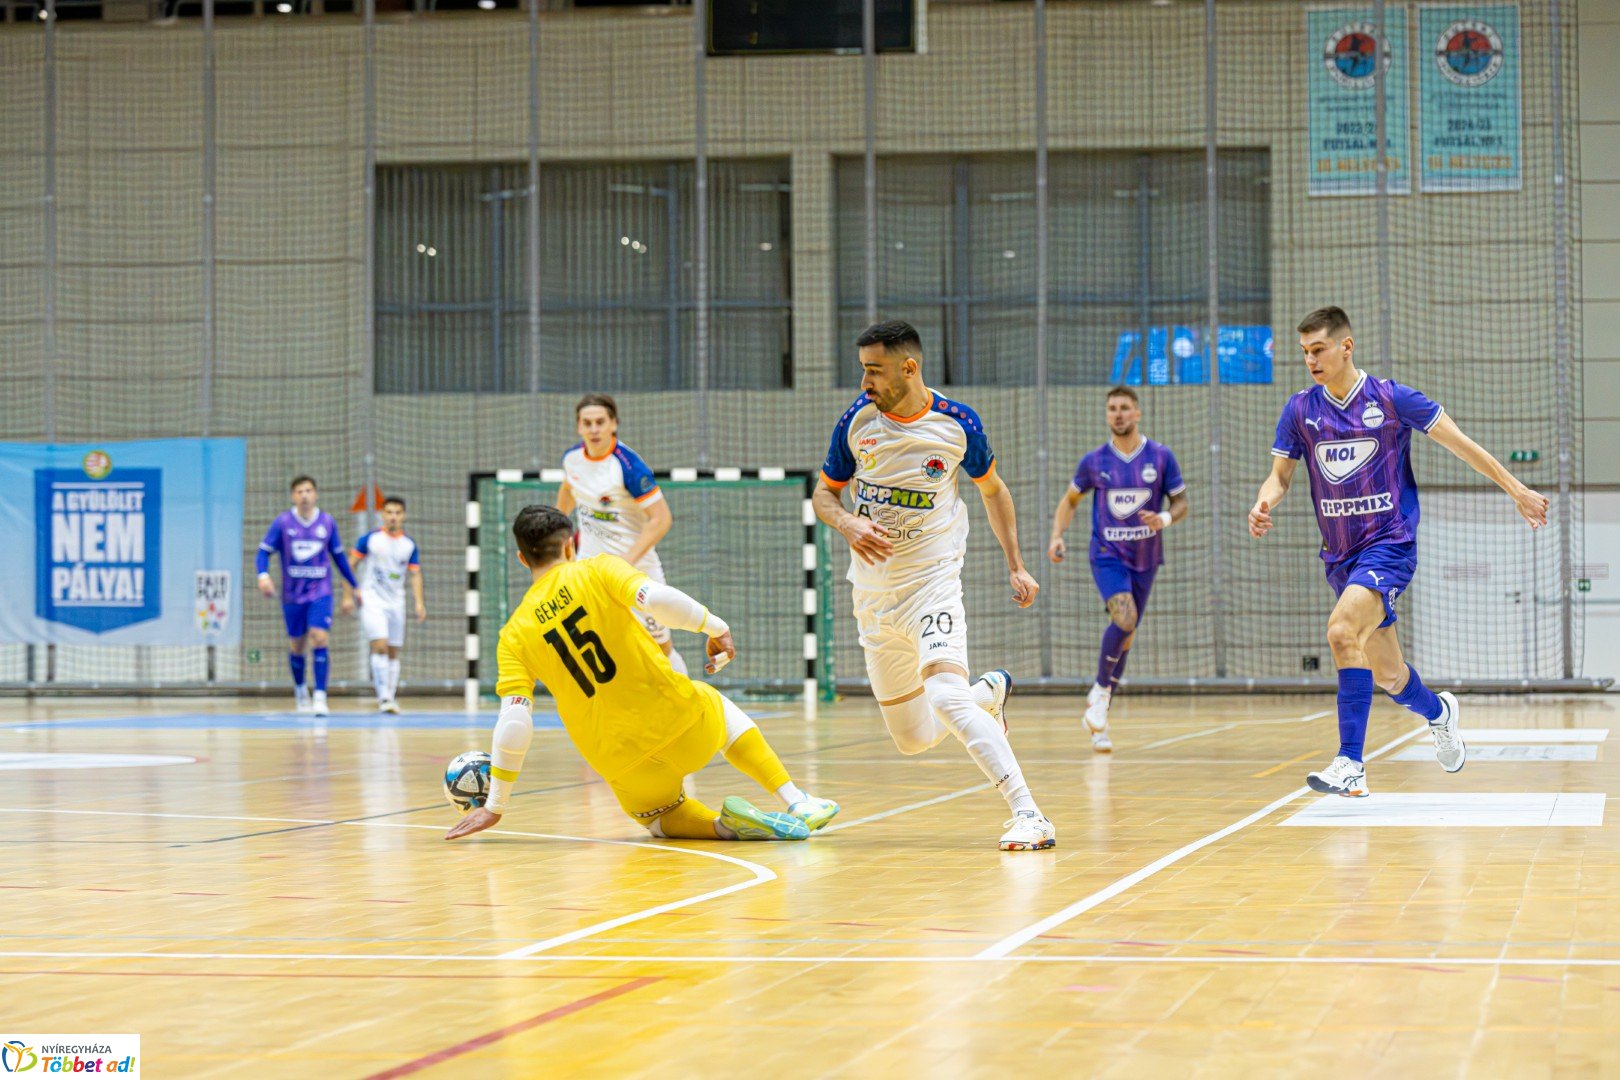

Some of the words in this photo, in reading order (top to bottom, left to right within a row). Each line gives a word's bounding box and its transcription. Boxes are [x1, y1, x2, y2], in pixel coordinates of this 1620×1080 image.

[1325, 446, 1356, 463] MOL
[856, 479, 937, 510] TIPPMIX
[1322, 493, 1392, 517] TIPPMIX
[52, 511, 145, 563] NEM
[1105, 527, 1156, 540] TIPPMI
[52, 562, 145, 601] PÁLYA!
[920, 611, 953, 638] 20
[543, 605, 616, 698] 15
[929, 641, 948, 650] JAKO
